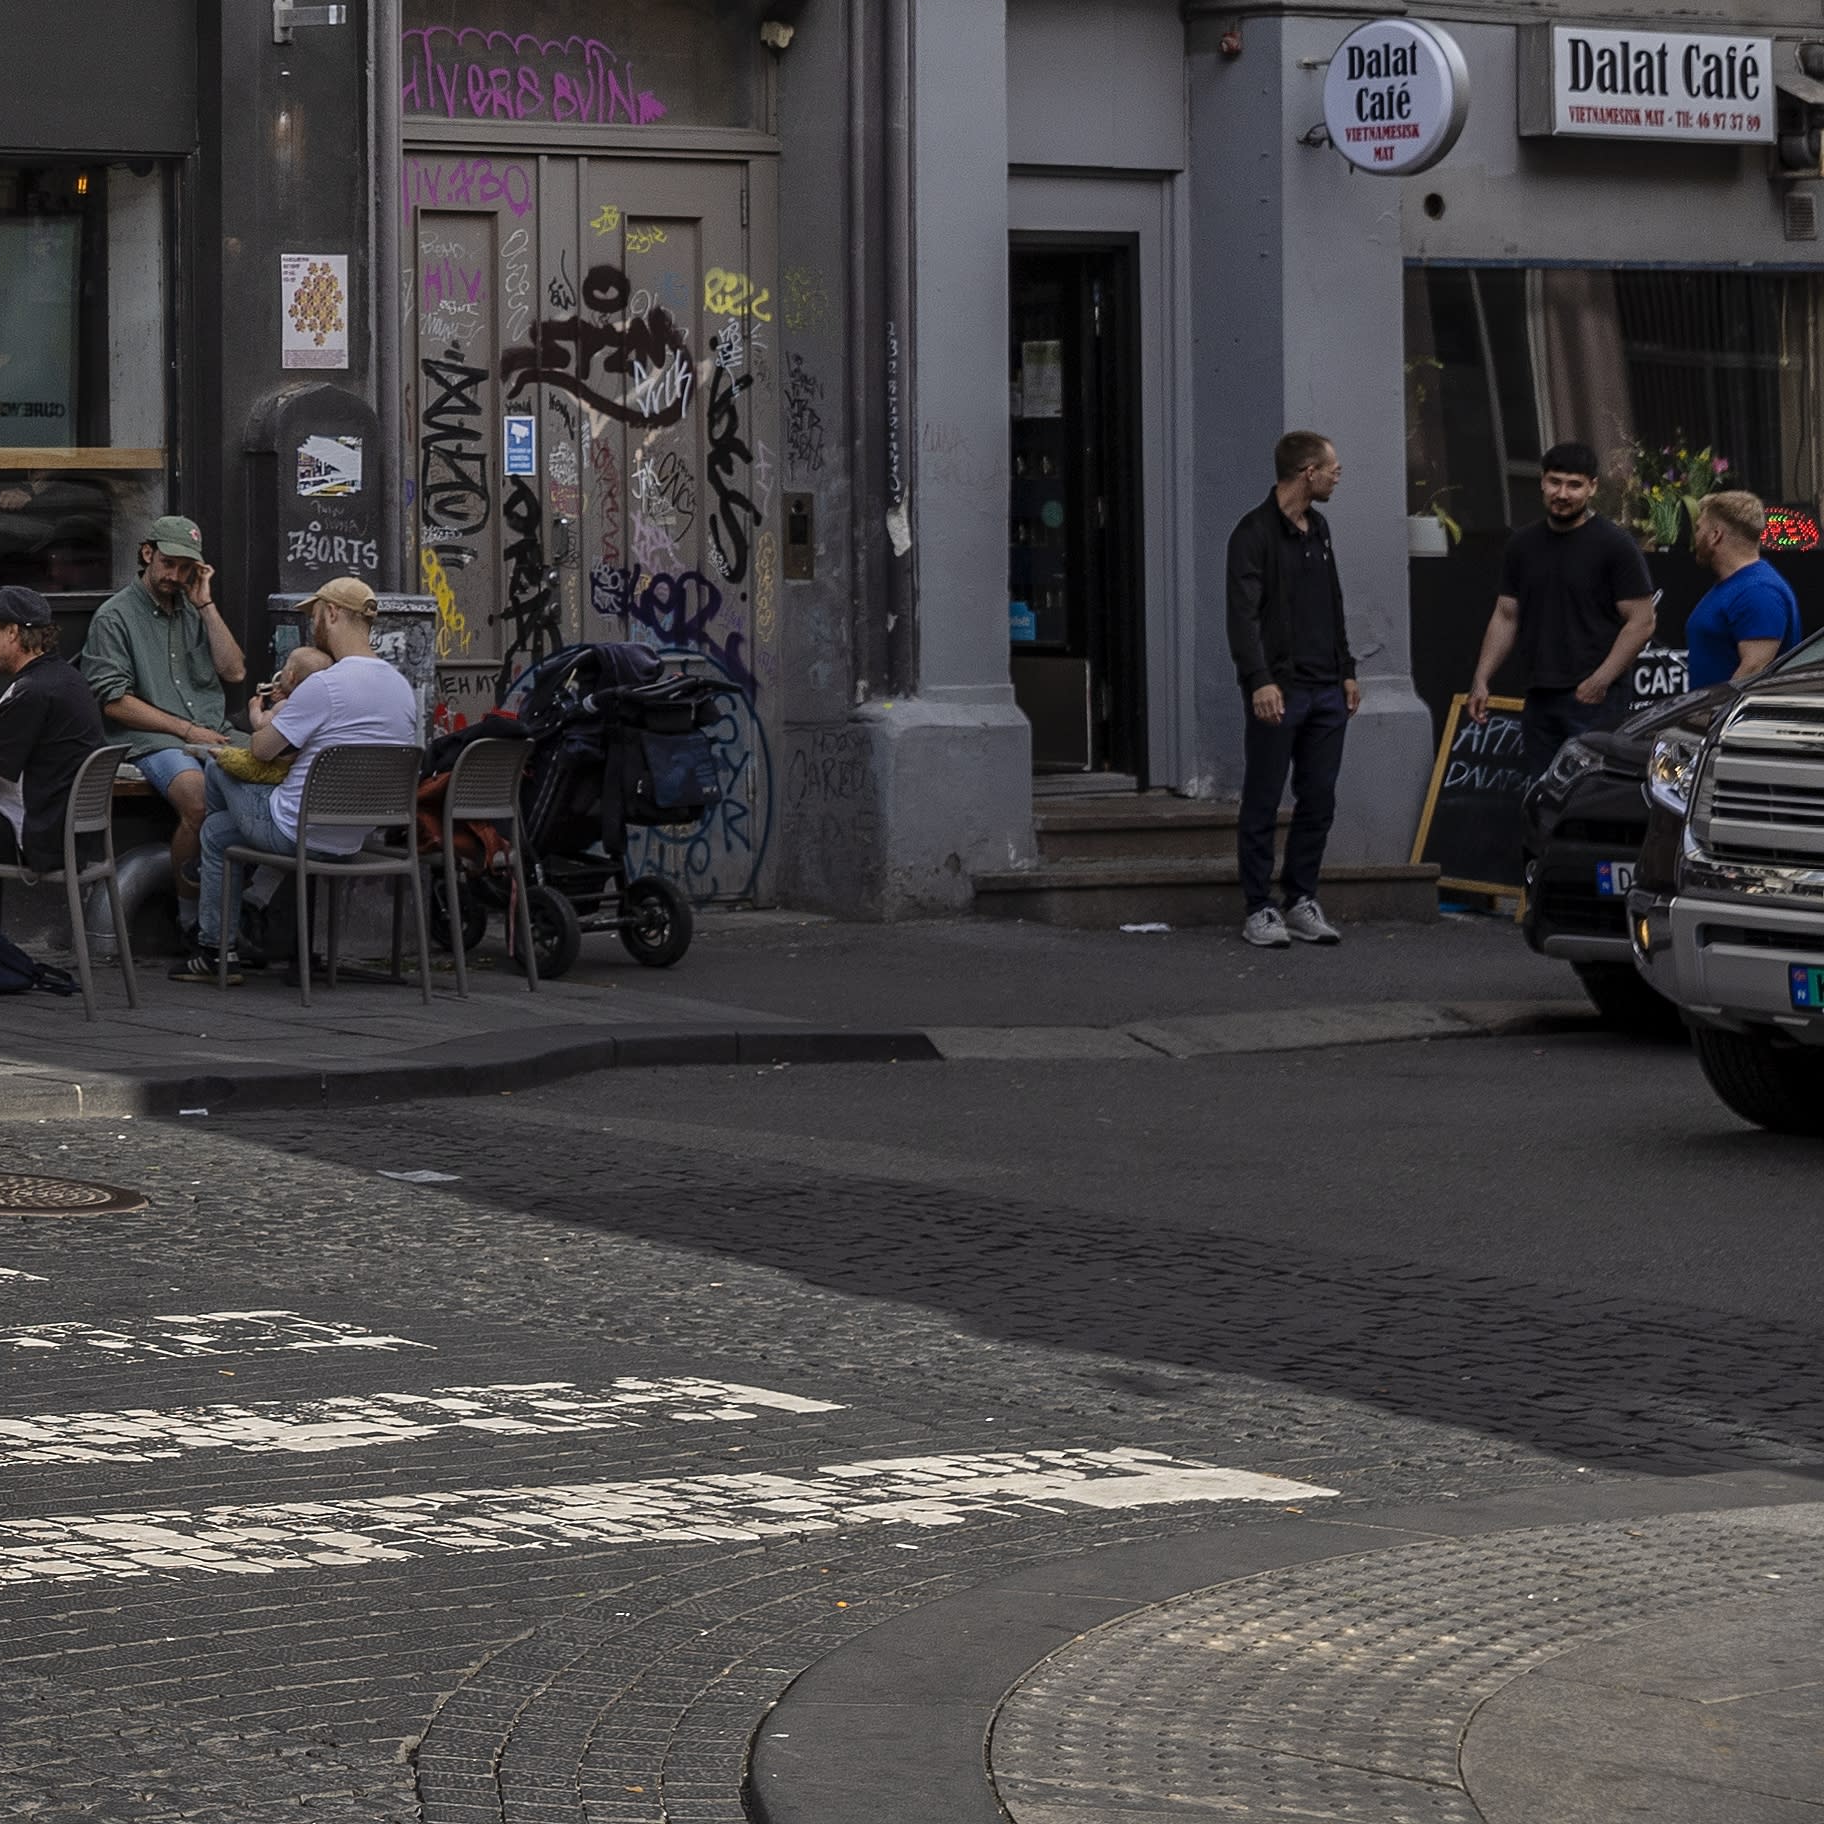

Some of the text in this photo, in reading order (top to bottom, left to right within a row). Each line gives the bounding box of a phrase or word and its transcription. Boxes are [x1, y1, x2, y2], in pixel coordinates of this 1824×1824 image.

[1347, 41, 1417, 80] Dalat
[1568, 39, 1759, 101] Dalat Café
[1356, 82, 1411, 122] Café
[1569, 106, 1641, 126] VIETNAMESISK
[1644, 110, 1665, 126] MAT
[1345, 124, 1420, 143] VIETNAMESISK
[1374, 146, 1394, 161] MAT
